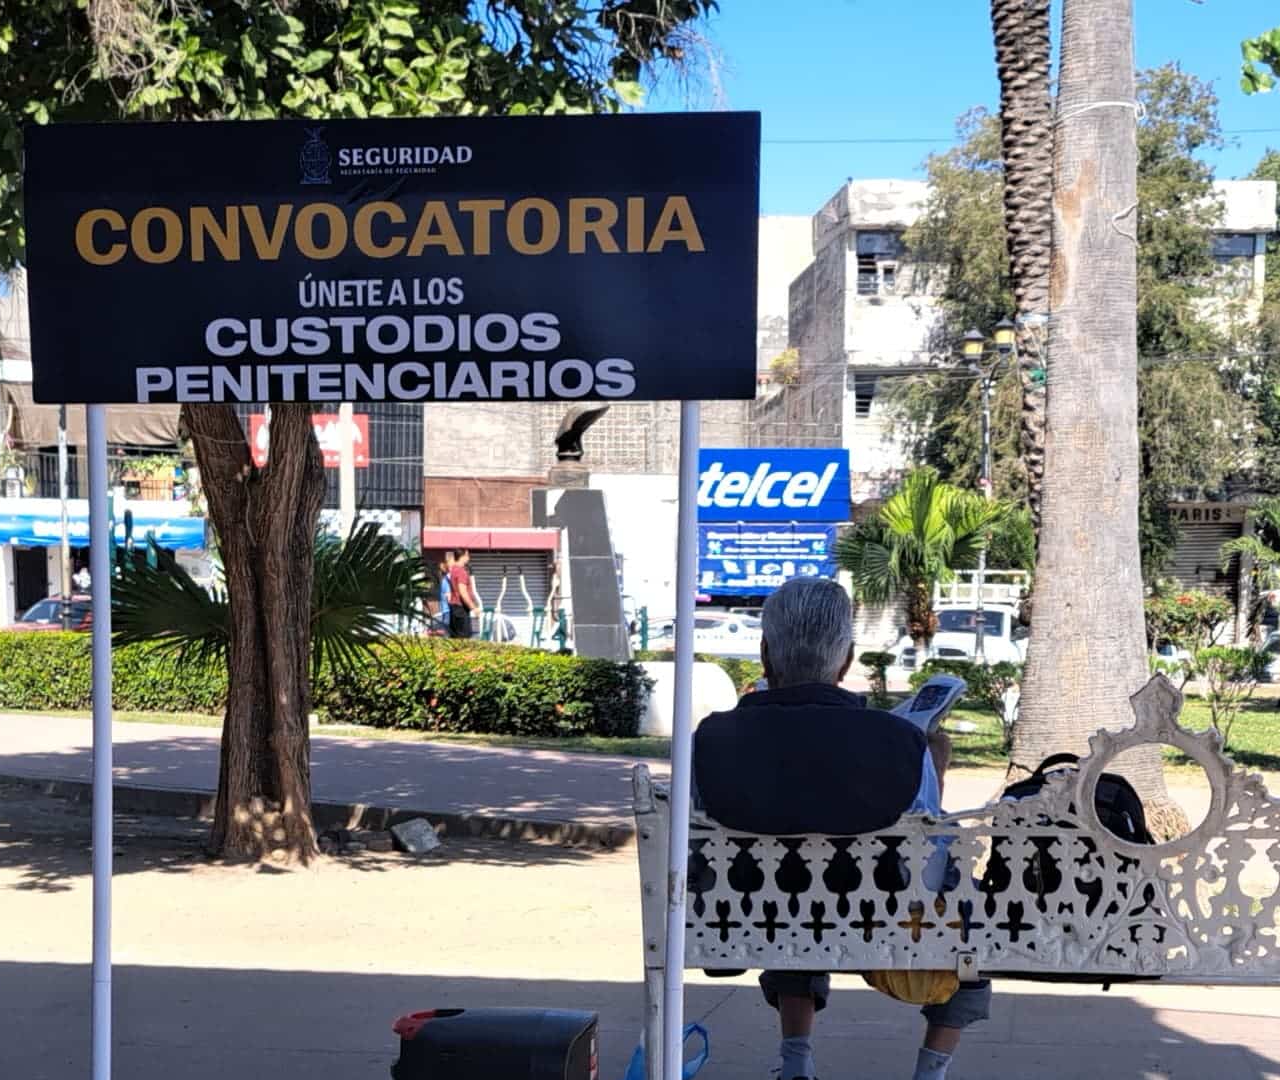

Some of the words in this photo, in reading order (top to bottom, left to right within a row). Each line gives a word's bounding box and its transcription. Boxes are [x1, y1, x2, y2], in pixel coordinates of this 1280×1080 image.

[338, 145, 472, 167] SEGURIDAD
[75, 195, 707, 266] CONVOCATORIA
[298, 273, 384, 309] ÚNETE
[389, 281, 407, 306] A
[413, 277, 464, 306] LOS
[204, 311, 562, 357] CUSTODIOS
[136, 357, 637, 403] PENITENCIARIOS
[697, 461, 840, 508] telcel
